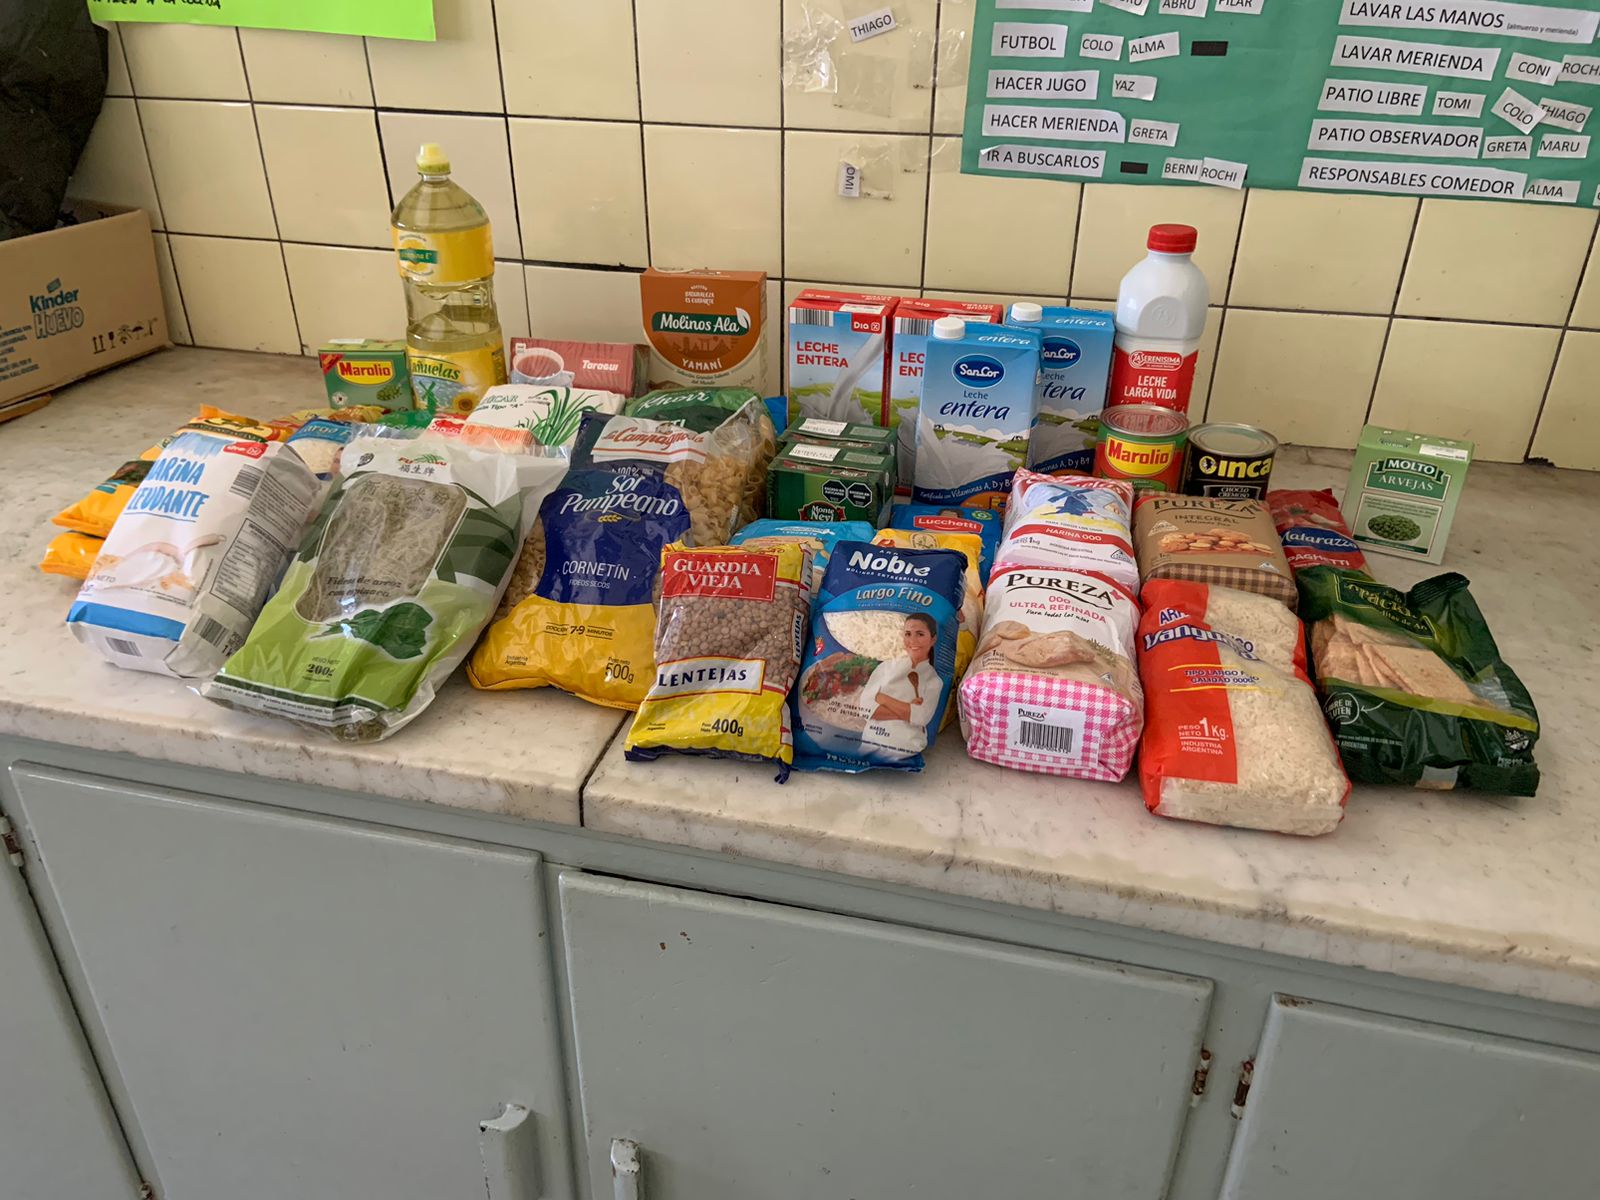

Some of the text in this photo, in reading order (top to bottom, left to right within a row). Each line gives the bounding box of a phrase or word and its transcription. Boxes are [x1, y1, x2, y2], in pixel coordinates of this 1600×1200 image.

[1349, 0, 1402, 20] LAVAR
[1405, 5, 1436, 22] LAS
[1439, 7, 1505, 29] MANOS
[850, 14, 892, 37] THIAGO
[1000, 35, 1058, 51] FUTBOL
[1082, 38, 1113, 52] COLO
[1130, 40, 1166, 56] ALMA
[1340, 44, 1484, 73] LAVAR MERIENDA
[1517, 61, 1552, 78] CONI
[1562, 61, 1600, 77] ROCH
[995, 76, 1087, 93] HACER JUGO
[1115, 79, 1136, 93] YAZ
[1325, 86, 1422, 108] PATIO LIBRE
[1437, 96, 1472, 110] TOMI
[1502, 102, 1534, 126] COLO
[1539, 103, 1587, 124] THIAGO
[990, 113, 1119, 135] HACER MERIENDA
[1132, 126, 1169, 142] GRETA
[1318, 127, 1480, 149] PATIO OBSERVADOR
[1487, 141, 1528, 154] GRETA
[1540, 140, 1580, 153] MARU
[1003, 152, 1014, 164] A
[1017, 152, 1100, 170] BUSCARLOS
[1165, 162, 1199, 176] BERNI
[845, 165, 856, 191] OMI
[1201, 167, 1238, 183] ROCHI
[1309, 166, 1516, 195] RESPONSABLES COMEDOR
[1526, 183, 1564, 198] ALMA
[29, 289, 80, 314] Kinder
[33, 306, 85, 340] HUEVO
[660, 313, 741, 333] Molinos Ala
[1055, 317, 1107, 327] entera
[796, 341, 840, 354] LECHE
[978, 335, 1031, 345] entera
[682, 357, 723, 371] YAMANÍ
[796, 354, 849, 369] ENTERA
[900, 351, 925, 365] LEC
[338, 361, 392, 377] Marolio
[412, 360, 461, 381] añuelas
[959, 363, 1000, 378] SanCor
[1137, 375, 1168, 387] LECHE
[963, 390, 989, 400] Leche
[1042, 381, 1087, 401] tera
[1124, 386, 1177, 400] LARGA VIDA
[939, 400, 1011, 421] entera
[303, 422, 339, 437] argo
[1109, 439, 1169, 465] Marolio
[1068, 459, 1074, 467] D
[1387, 459, 1436, 475] MOLTO
[605, 474, 646, 495] Sol
[992, 480, 998, 489] D
[1378, 474, 1435, 492] ARVEJAS
[126, 484, 210, 518] LEUDANTE
[559, 491, 679, 516] Pampeano
[1153, 499, 1256, 515] PUREZA
[811, 504, 835, 515] Monte
[917, 518, 978, 530] Lucchetti
[1174, 514, 1240, 525] INTEGRAL
[1045, 528, 1081, 539] HARINA
[672, 558, 761, 577] GUARDIA
[848, 550, 931, 577] Noble
[1287, 552, 1350, 567] PAGHETTI
[562, 560, 630, 581] CORNETÍN
[846, 567, 875, 576] MOLINOS
[688, 573, 743, 590] VIEJA
[856, 587, 895, 600] Largo
[897, 586, 933, 606] Fino
[1004, 574, 1115, 607] PUREZA
[1009, 601, 1107, 623] ULTRA REFINADA
[793, 613, 803, 660] LENTEJAS
[605, 662, 635, 684] 500g
[658, 667, 748, 688] LENTEJAS
[1018, 708, 1045, 719] PUREZA
[711, 718, 744, 737] 400g
[1199, 717, 1210, 737] 1
[1180, 740, 1223, 750] INDUSTRIA
[1180, 745, 1224, 756] ARGENTINA
